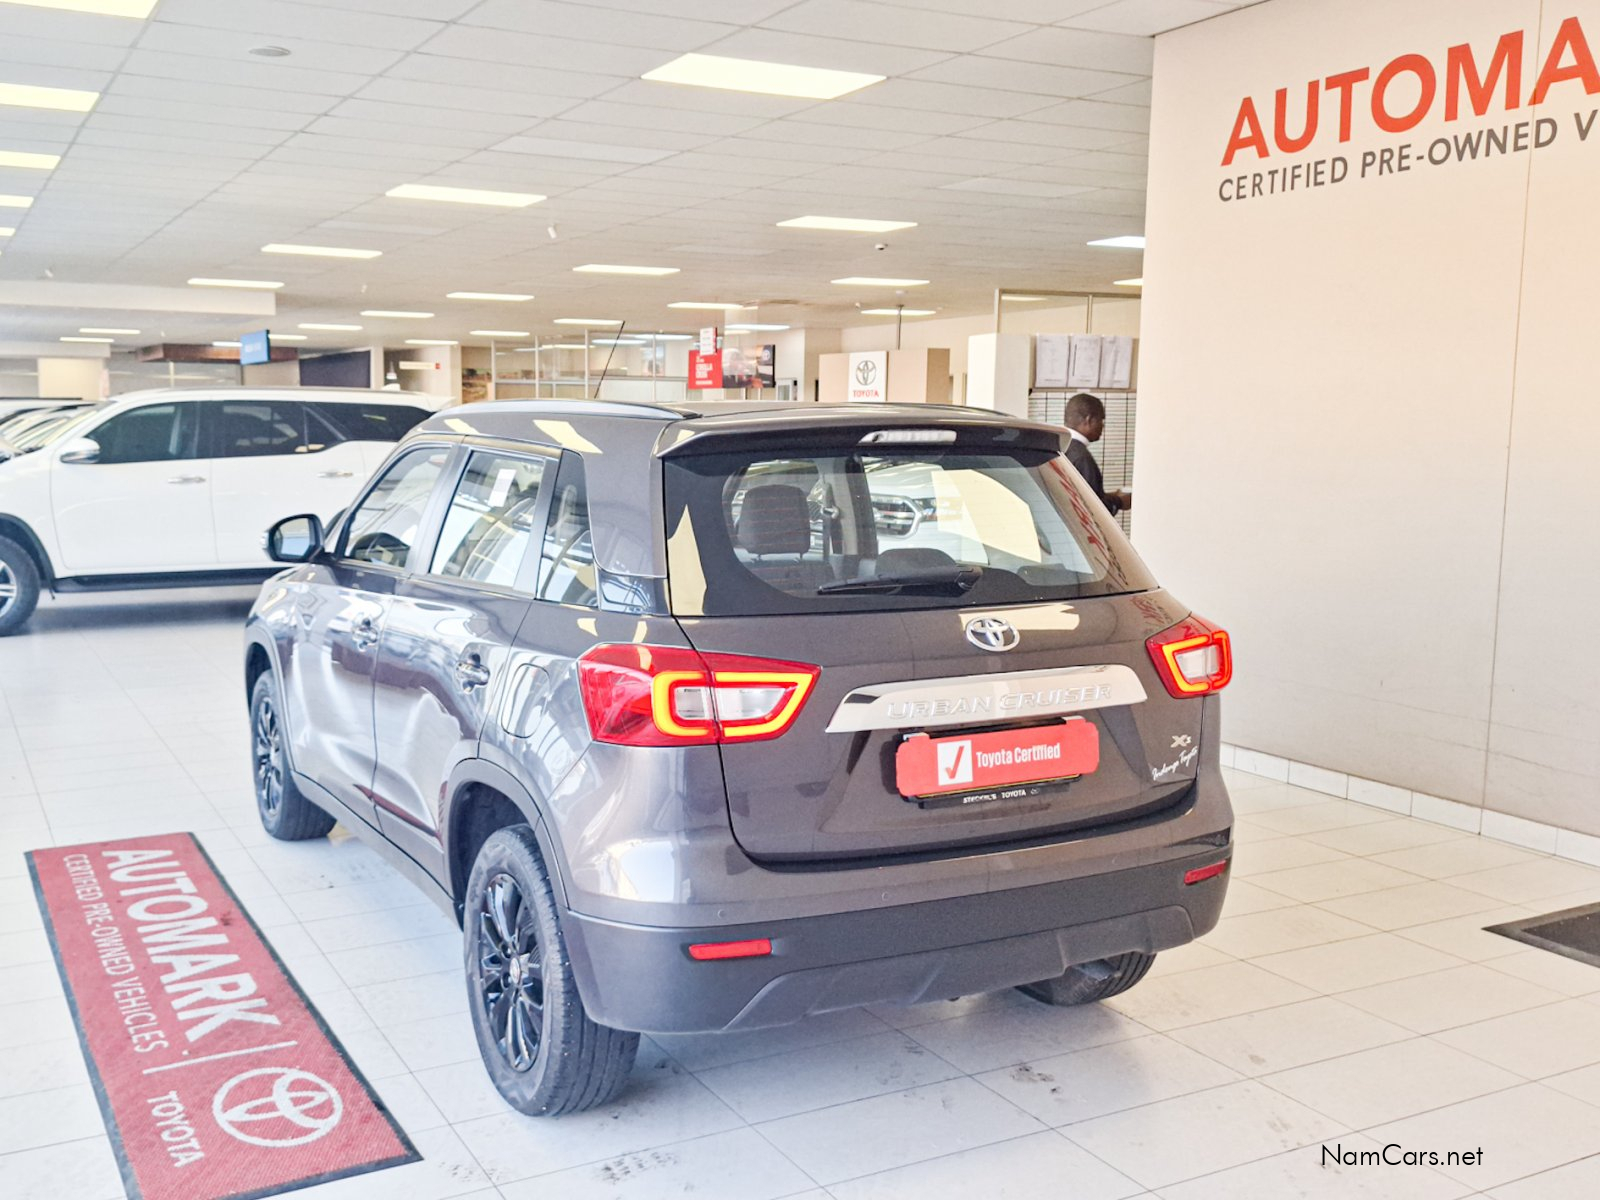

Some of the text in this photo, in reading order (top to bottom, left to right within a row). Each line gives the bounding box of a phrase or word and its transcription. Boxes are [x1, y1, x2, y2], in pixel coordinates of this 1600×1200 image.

[1220, 16, 1600, 167] AUTOMA
[1218, 156, 1349, 202] CERTIFIED
[1360, 117, 1558, 178] PRE-OWNED
[852, 389, 880, 398] TOYOTA
[887, 683, 1112, 720] URBAN CRUISER
[976, 742, 1061, 768] Toyota Certified
[1001, 789, 1027, 799] TOYOTA
[63, 853, 169, 1053] CERTIFIED PRE-OWNED VEHICLES
[101, 849, 282, 1042] AUTOMARK
[147, 1090, 205, 1168] TOYOTA
